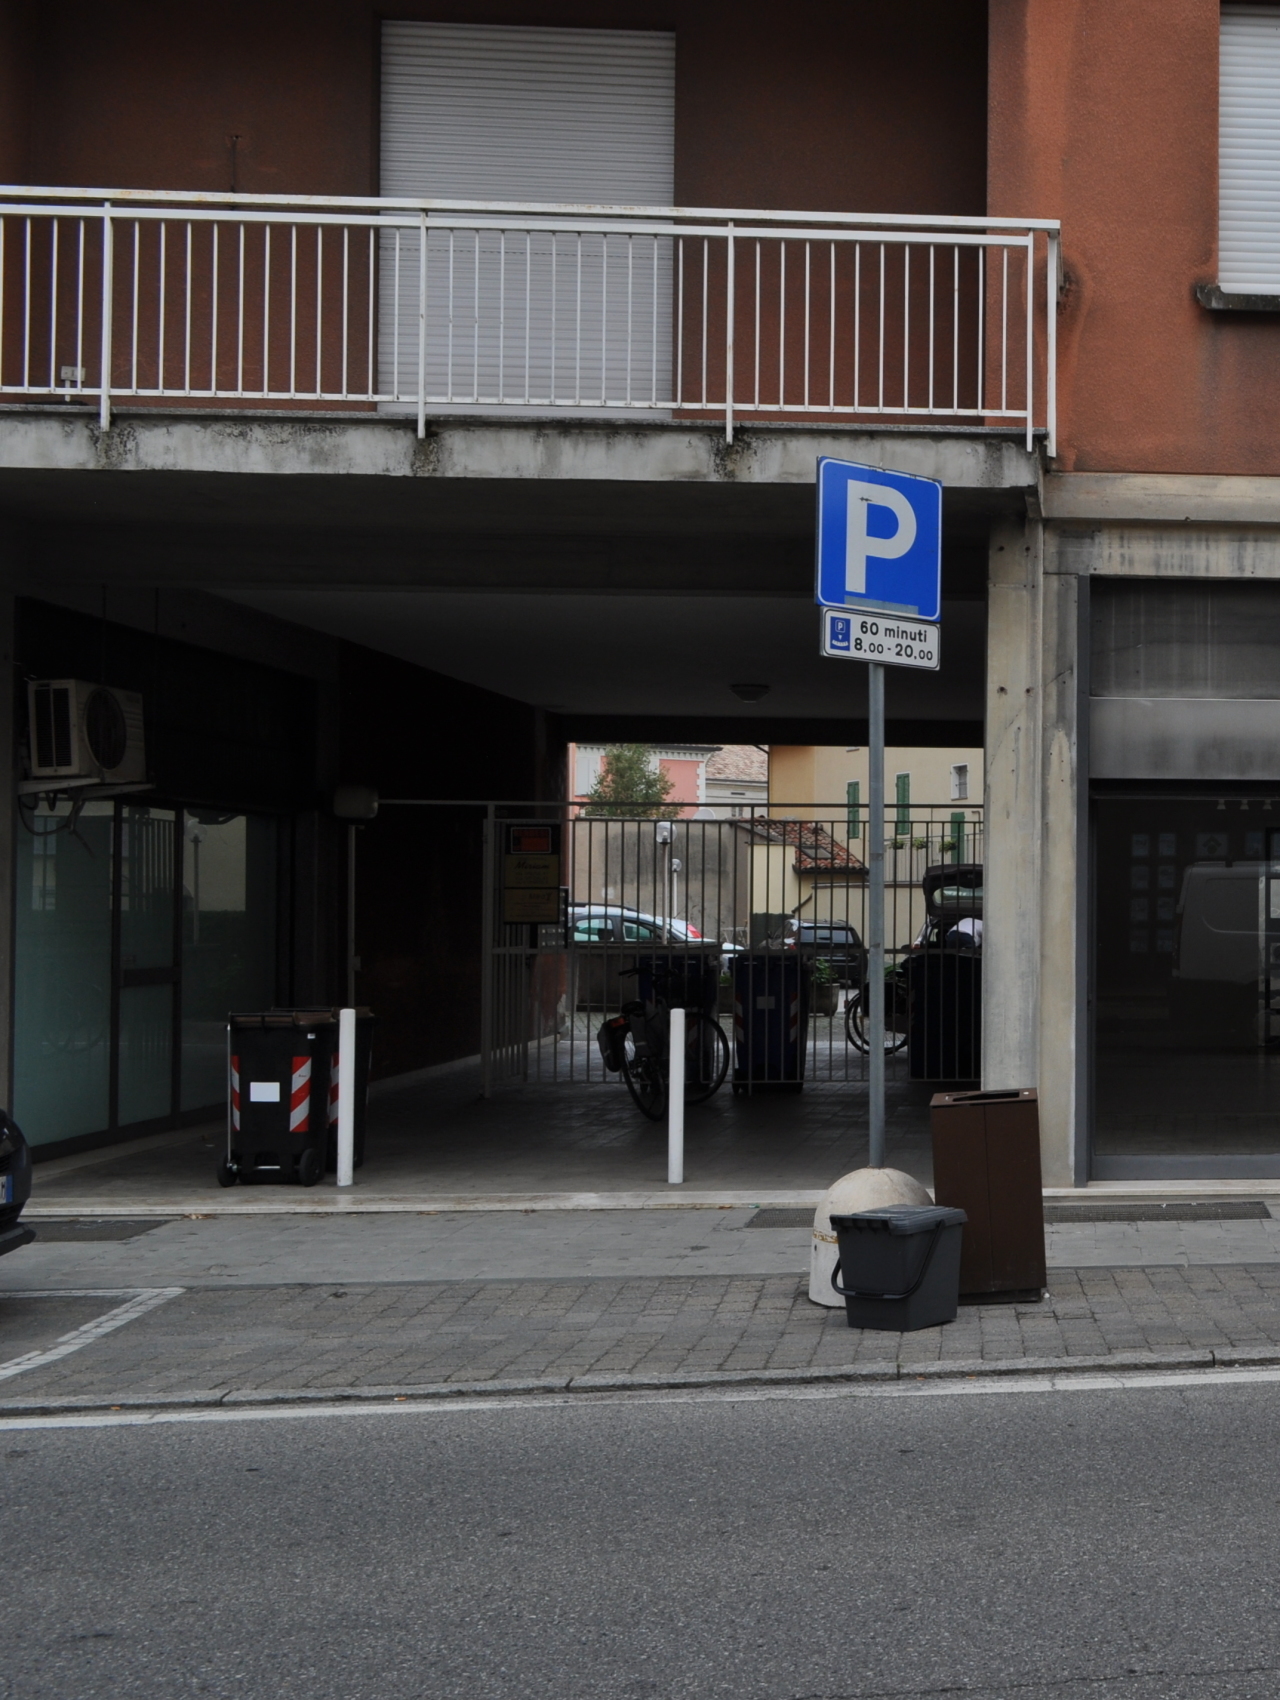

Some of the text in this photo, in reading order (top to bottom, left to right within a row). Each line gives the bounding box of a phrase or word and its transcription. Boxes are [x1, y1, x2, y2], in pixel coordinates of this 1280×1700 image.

[845, 479, 917, 594] P
[837, 622, 843, 630] P
[860, 621, 927, 643] 60 minuti
